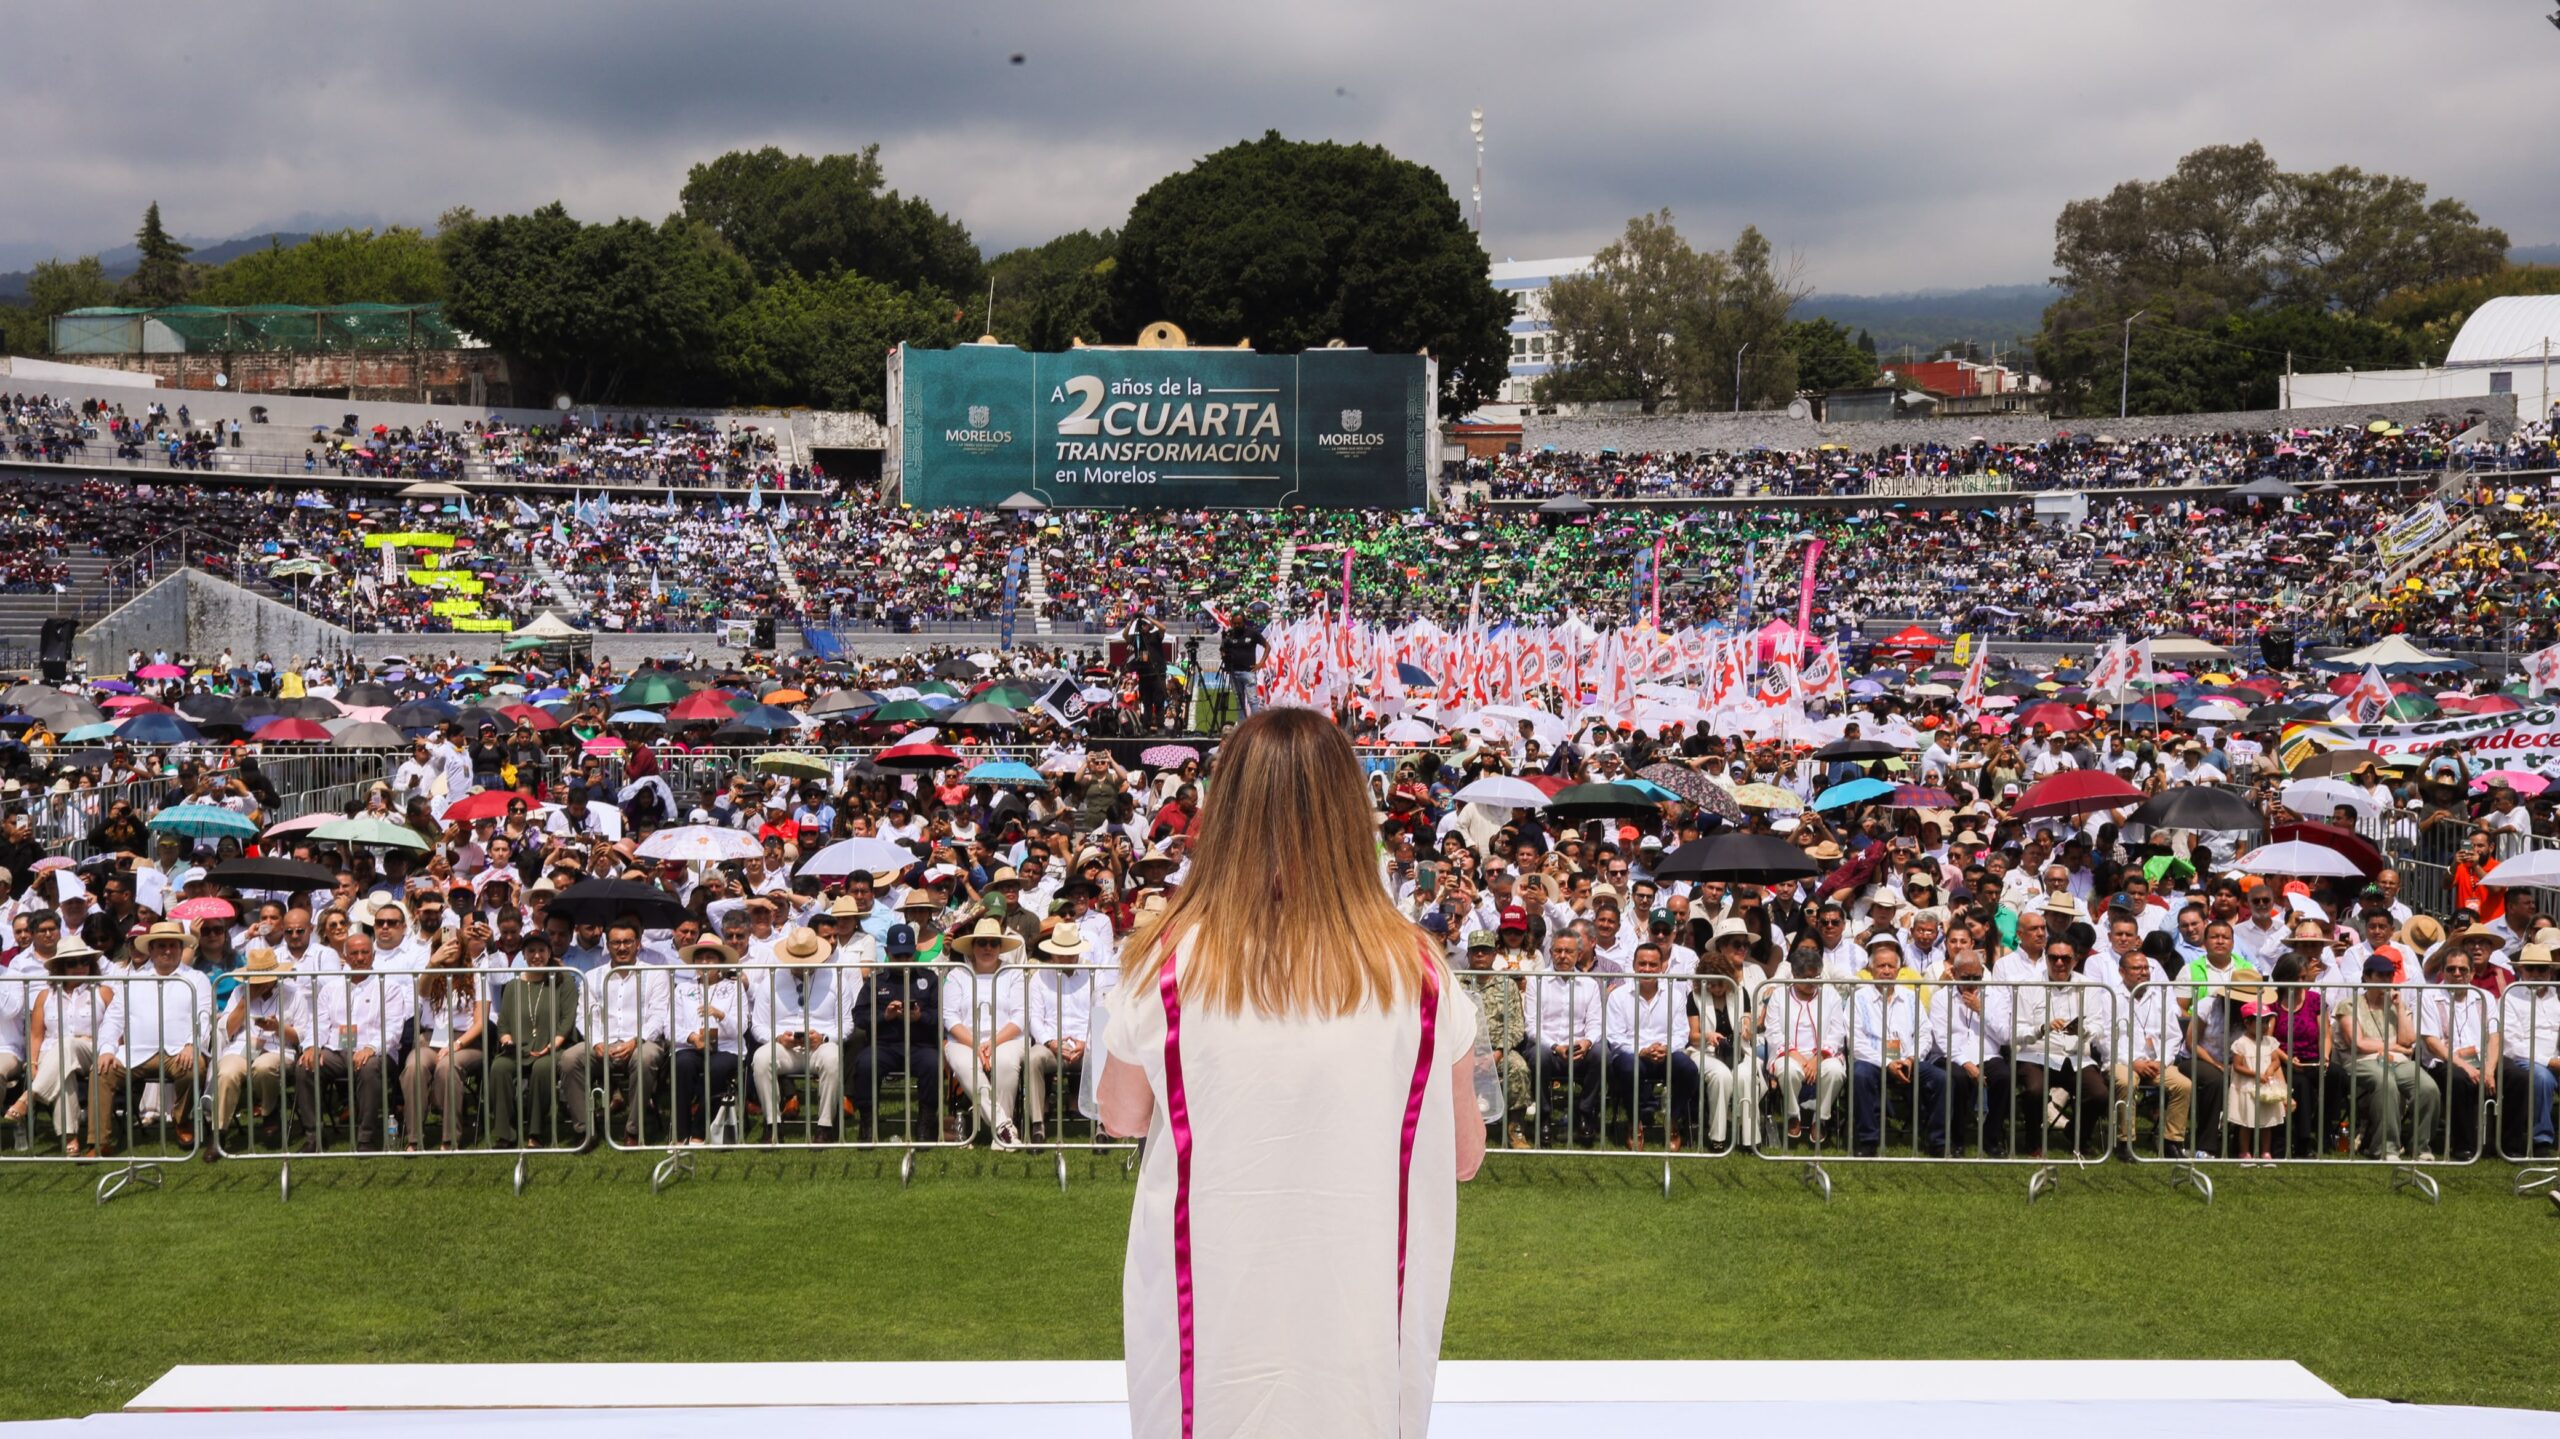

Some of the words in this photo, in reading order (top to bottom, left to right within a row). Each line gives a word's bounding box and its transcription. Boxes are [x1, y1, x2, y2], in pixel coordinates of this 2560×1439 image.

[1050, 386, 1065, 402] A
[1111, 378, 1153, 395] años
[1158, 376, 1181, 395] de
[1187, 376, 1202, 395] la
[1057, 374, 1105, 435] 2
[1103, 401, 1281, 437] CUARTA
[945, 429, 1012, 443] MORELOS
[1318, 433, 1385, 446] MORELOS
[1056, 438, 1280, 462] TRANSFORMACIÓN
[1055, 469, 1077, 483] en
[1084, 465, 1157, 483] Morelos
[2358, 725, 2401, 737] EL
[2412, 709, 2556, 736] CAMPO
[2368, 739, 2398, 756] le
[2408, 728, 2560, 754] aadece
